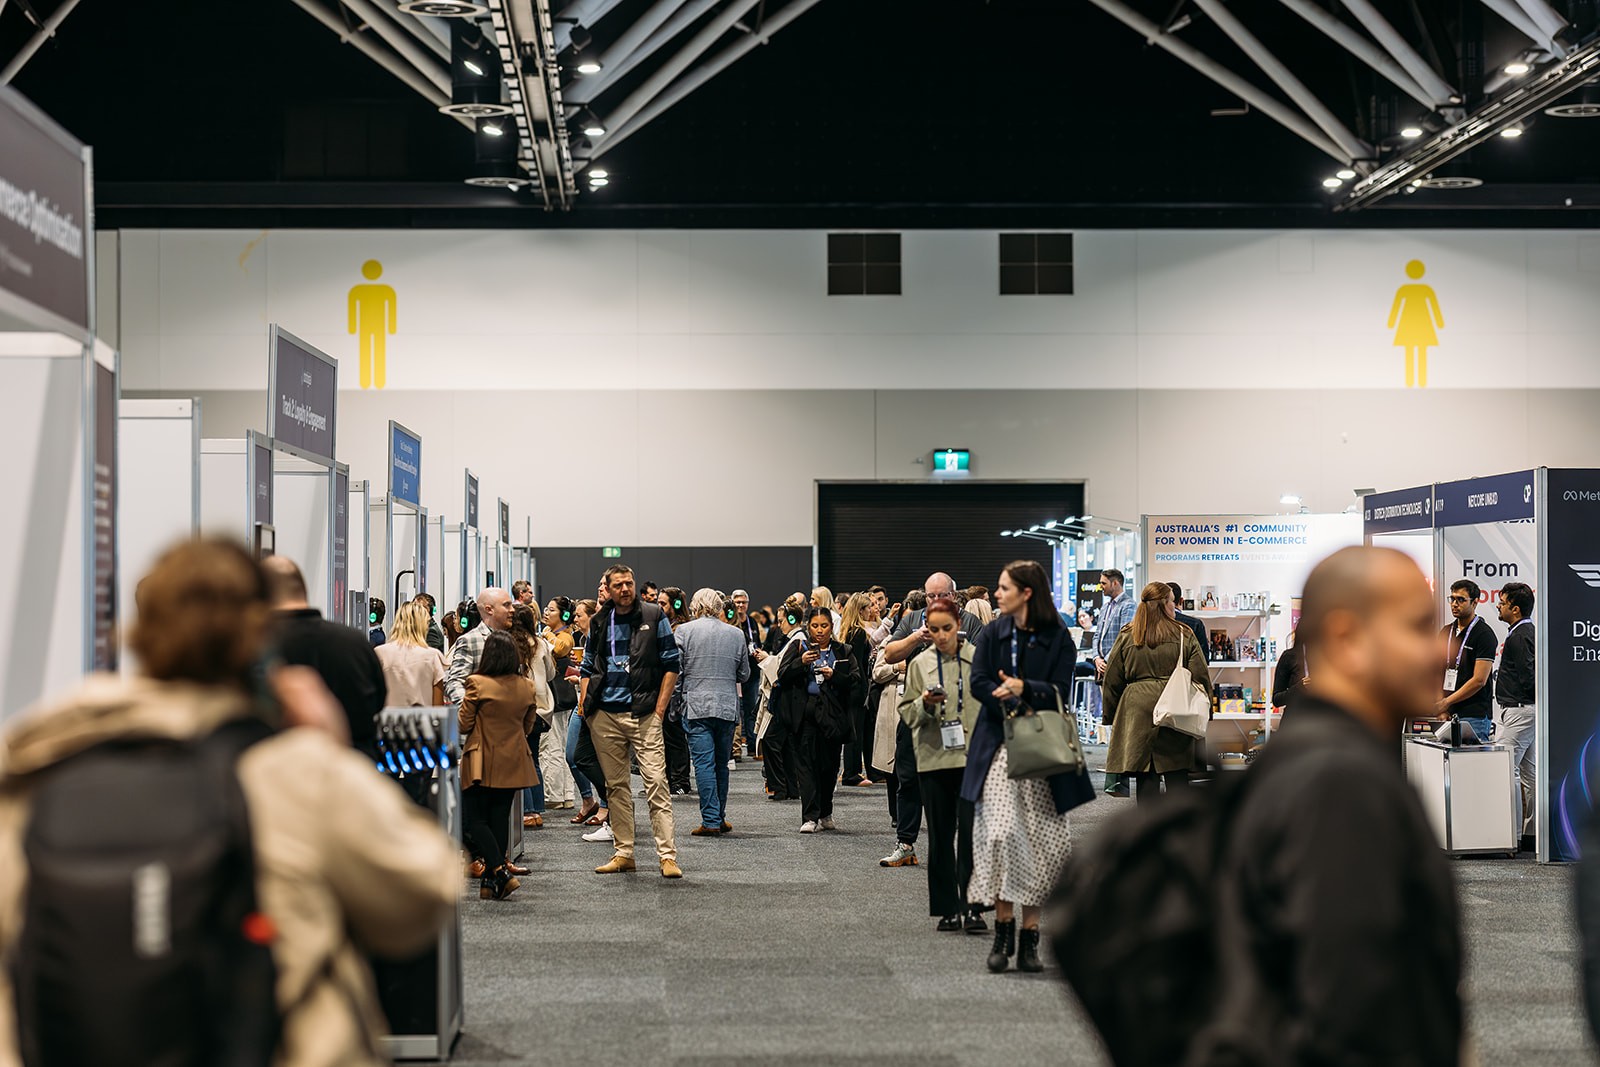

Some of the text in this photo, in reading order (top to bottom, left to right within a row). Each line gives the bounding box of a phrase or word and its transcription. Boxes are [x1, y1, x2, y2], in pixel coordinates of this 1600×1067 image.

[282, 394, 291, 416] Track
[295, 400, 306, 427] Loyalty
[309, 406, 326, 432] Engagement
[1155, 524, 1307, 533] AUSTRALIA'S #1 COMMUNITY
[1155, 536, 1307, 545] FOR WOMEN IN E-COMMERCE
[1463, 559, 1518, 577] From
[1573, 620, 1600, 641] Dig
